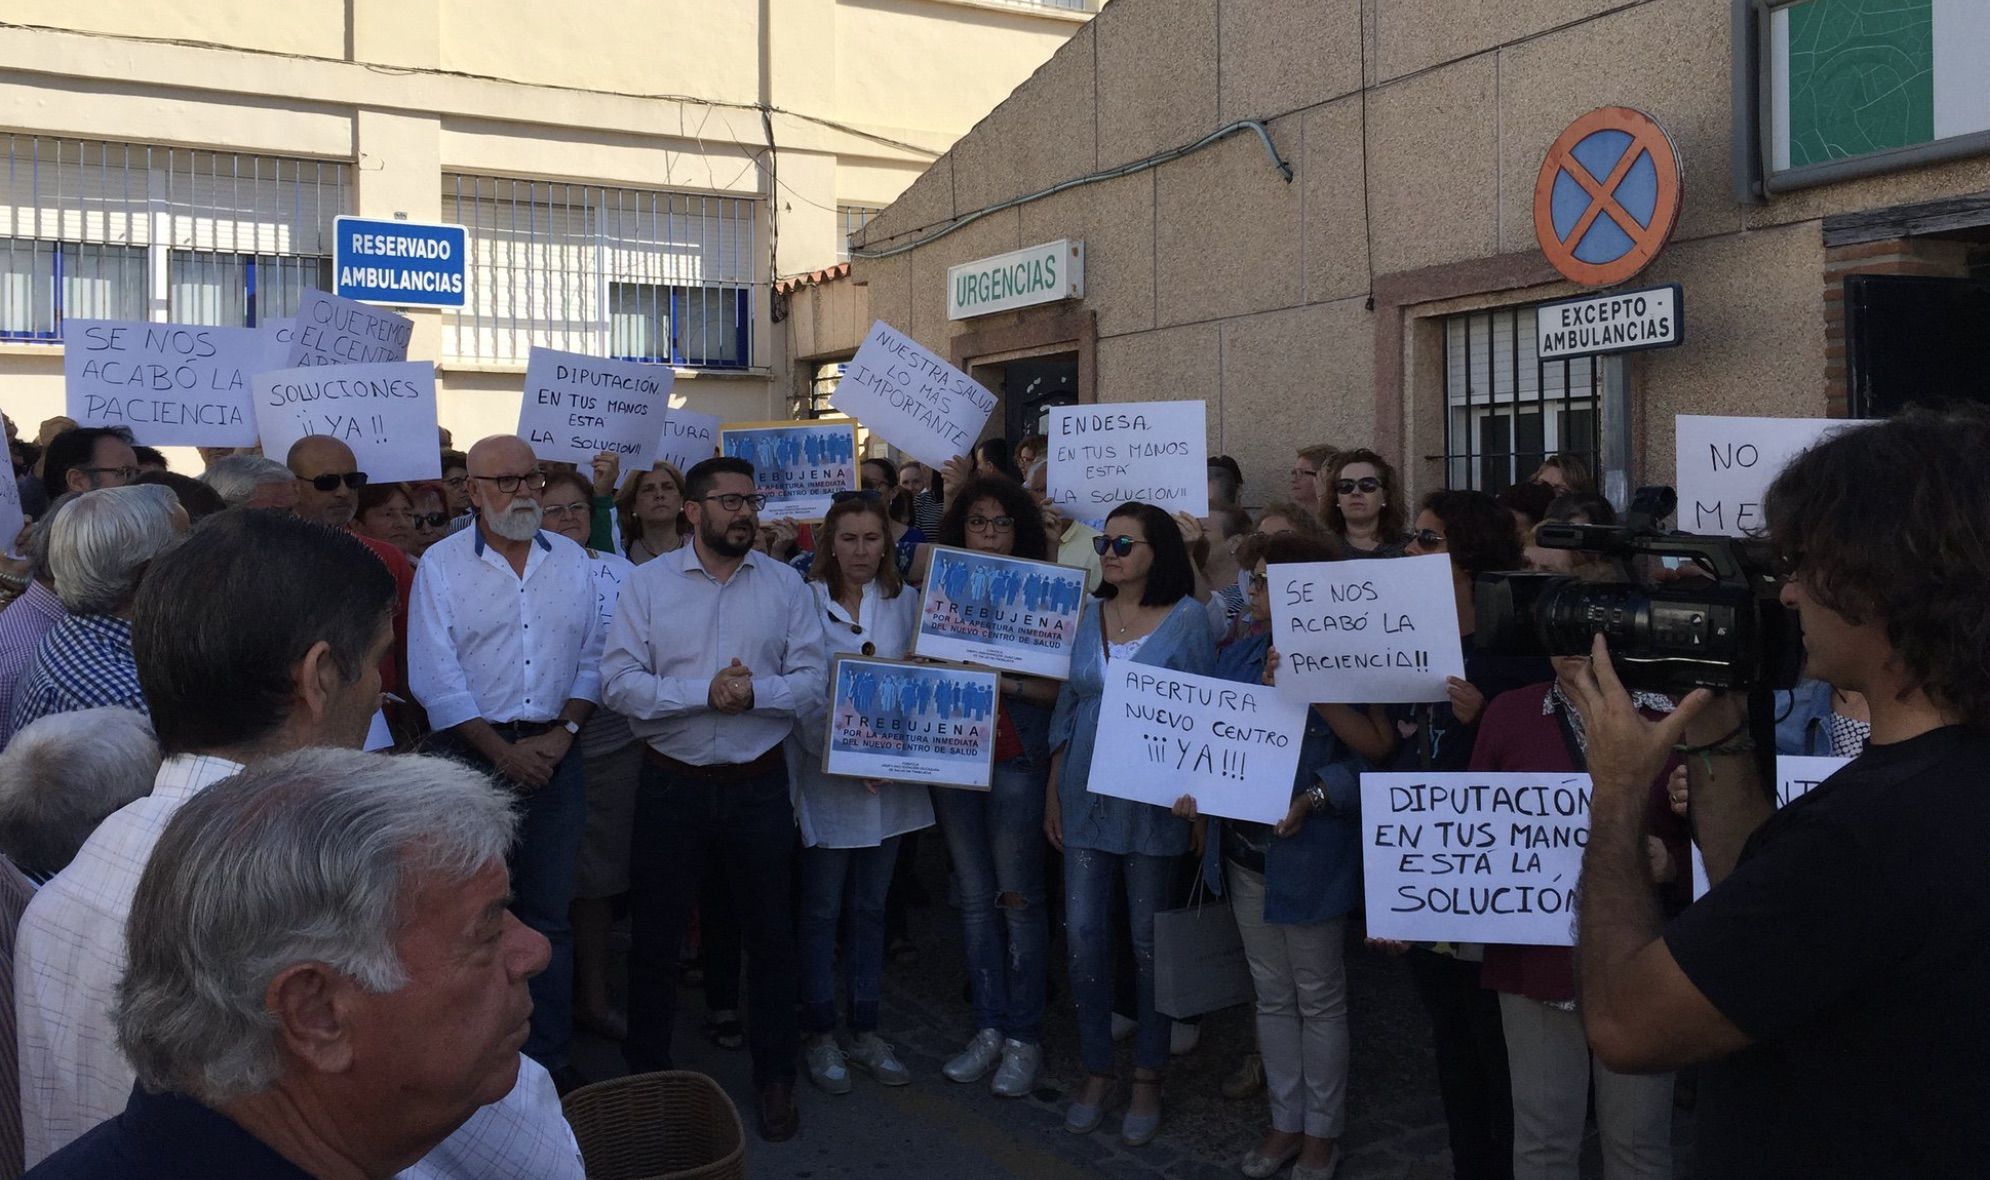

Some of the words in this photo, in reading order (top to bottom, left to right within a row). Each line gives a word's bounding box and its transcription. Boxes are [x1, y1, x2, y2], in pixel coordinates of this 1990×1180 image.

[352, 233, 451, 260] RESERVADO
[340, 266, 463, 293] AMBULANCIAS
[957, 254, 1056, 307] URGENCIAS
[1561, 297, 1646, 327] EXCEPTO
[85, 327, 127, 351] SE
[145, 329, 216, 357] NOS
[300, 326, 327, 352] EL
[1543, 317, 1670, 352] AMBULANCIAS
[876, 331, 949, 385] NUESTRA
[82, 359, 197, 391] ACABÓ
[212, 368, 244, 391] LA
[270, 379, 419, 407] SOLUCIONES
[538, 388, 561, 407] EN
[568, 393, 597, 410] TUS
[607, 400, 649, 416] MANOS
[887, 364, 911, 386] LO
[919, 385, 952, 414] MÁS
[85, 394, 243, 425] PACIENCIA
[853, 365, 969, 447] IMPORTANTE
[530, 429, 555, 444] LA
[664, 421, 710, 440] TURA
[1057, 447, 1076, 462] EN
[1082, 446, 1117, 460] TUS
[1129, 442, 1189, 459] MANOS
[1710, 443, 1758, 471] NO
[760, 468, 845, 482] EBUJENA
[1086, 464, 1130, 480] ESTÁ
[1053, 488, 1077, 504] LA
[1287, 580, 1314, 606] SE
[1331, 581, 1378, 603] NOS
[933, 613, 950, 622] POR
[969, 619, 1014, 633] APERTURA
[1018, 627, 1062, 641] INMEDIATA
[936, 600, 1064, 631] TREBUJENA
[1291, 612, 1369, 633] ACABÓ
[1384, 613, 1415, 633] LA
[931, 622, 946, 631] DEL
[950, 625, 978, 636] NUEVO
[982, 630, 1015, 642] CENTRO
[1019, 636, 1029, 644] DE
[1033, 638, 1061, 649] SALUD
[1126, 671, 1256, 713] APERTURA
[843, 729, 861, 738] POR
[866, 731, 879, 739] LA
[882, 732, 928, 743] APERTURA
[933, 736, 979, 747] INMEDIATA
[845, 715, 979, 737] TREBUJENA
[1126, 703, 1194, 731] NUEVO
[1212, 721, 1288, 747] CENTRO
[842, 738, 859, 746] DEL
[863, 740, 892, 750] NUEVO
[896, 743, 931, 753] CENTRO
[934, 746, 945, 754] DE
[950, 747, 978, 757] SALUD
[1375, 824, 1422, 848] EN
[1434, 822, 1496, 848] TUS
[1510, 823, 1590, 849] MANO
[1399, 849, 1496, 874] ESTÁ
[1512, 852, 1541, 873] LA
